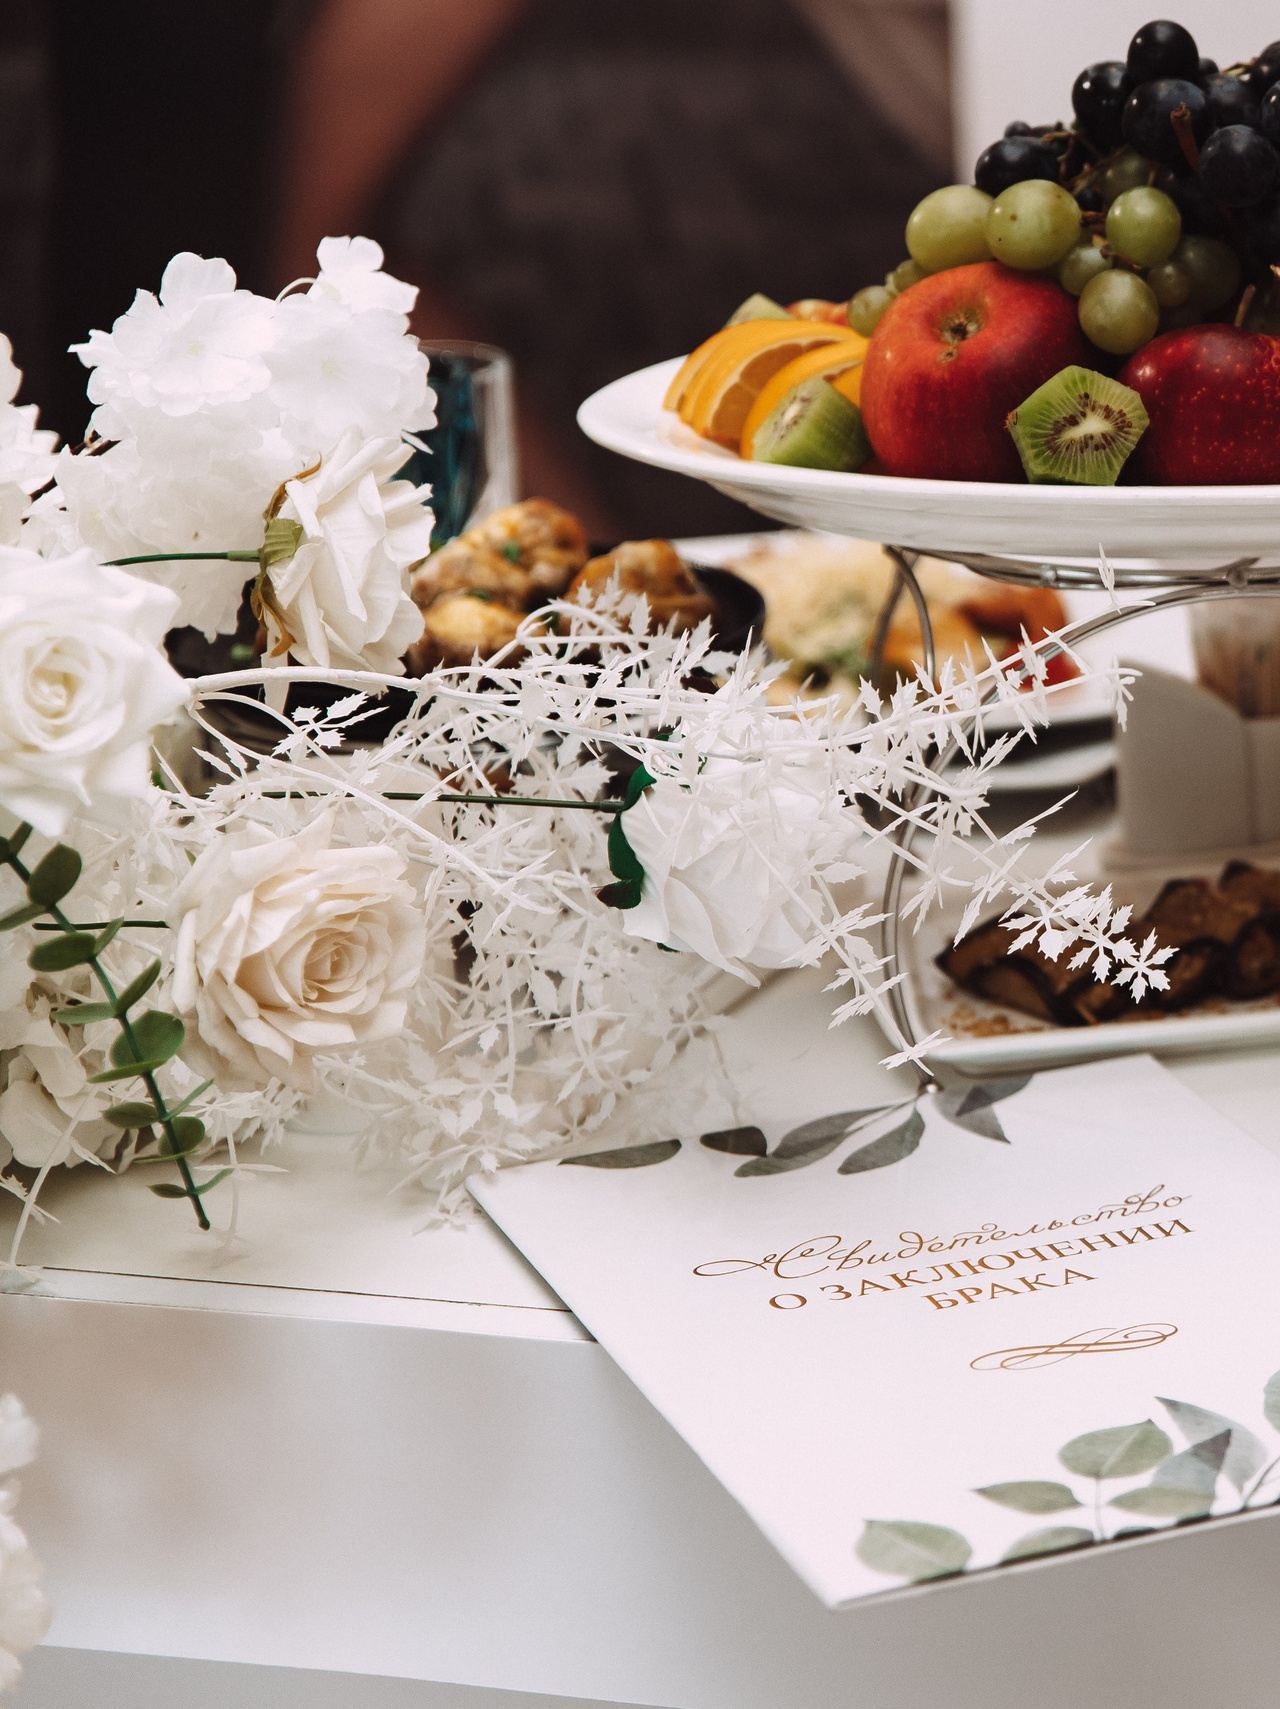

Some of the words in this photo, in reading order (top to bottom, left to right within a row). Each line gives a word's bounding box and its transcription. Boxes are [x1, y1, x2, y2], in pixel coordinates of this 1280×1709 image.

[692, 1183, 1193, 1280] Свидетельство
[768, 1292, 808, 1311] О
[819, 1217, 1196, 1302] ЗАКЛЮЧЕНИИ
[920, 1267, 1099, 1311] БРАКА
